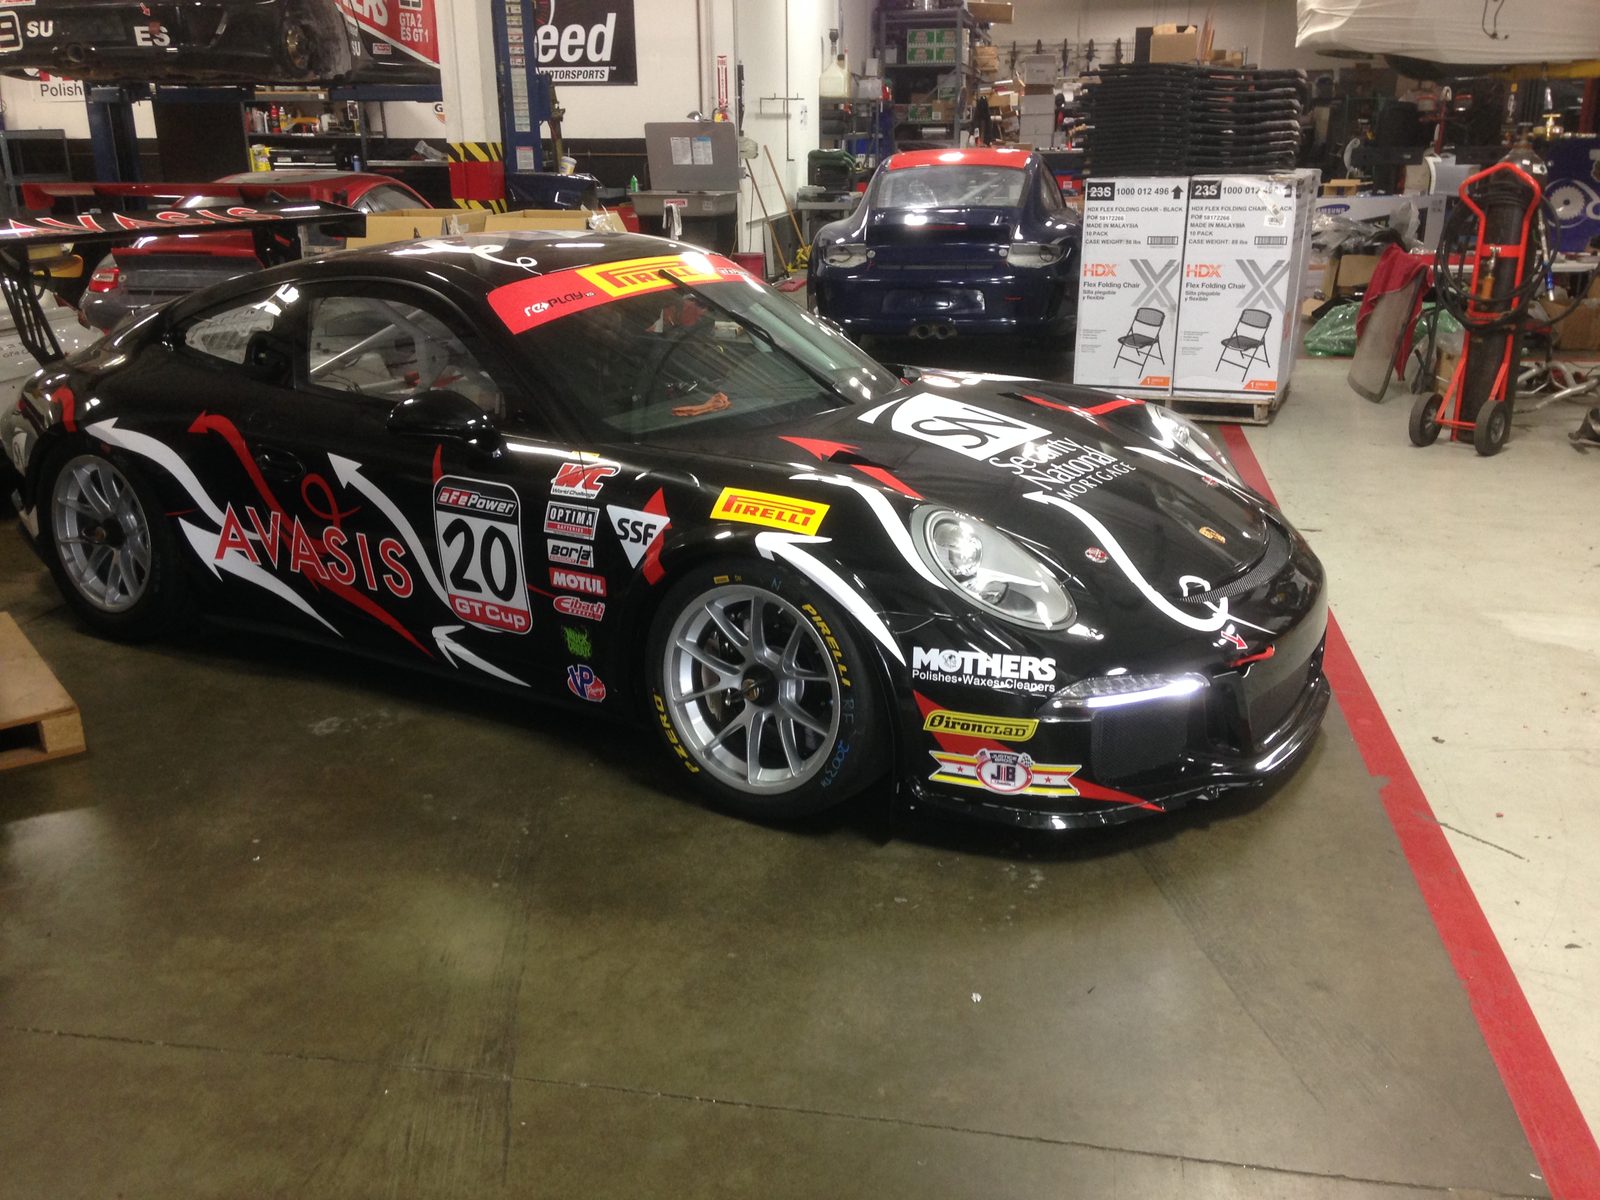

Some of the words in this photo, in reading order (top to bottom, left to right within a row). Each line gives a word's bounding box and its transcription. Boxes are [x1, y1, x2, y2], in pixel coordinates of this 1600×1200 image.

[26, 20, 53, 38] SU
[399, 12, 417, 27] GTA
[417, 14, 423, 27] 2
[134, 25, 171, 47] ES
[412, 29, 425, 43] GT
[535, 12, 617, 63] eed
[540, 69, 606, 81] MOTORSPORTS
[1089, 186, 1111, 198] 23S
[1116, 187, 1135, 196] 1000
[1137, 187, 1152, 196] 012
[1154, 187, 1169, 196] 496
[1195, 184, 1218, 196] 23S
[1223, 186, 1242, 195] 1000
[596, 260, 704, 289] PIRLL
[1083, 263, 1117, 277] HDX
[1185, 263, 1222, 278] HDX
[1097, 281, 1121, 290] Folding
[1201, 282, 1226, 290] Folding
[1019, 445, 1118, 491] National
[1056, 461, 1137, 501] MORTGAGE
[549, 507, 593, 526] OPTIMA
[722, 495, 816, 527] PIRELLI
[617, 518, 657, 546] SSF
[214, 501, 414, 599] AVASIS
[442, 518, 518, 602] 20
[553, 571, 604, 595] MOTUL
[455, 597, 482, 617] GT
[485, 605, 526, 629] Cup
[801, 604, 851, 687] PIRELLI
[912, 646, 1057, 682] MOTHERS
